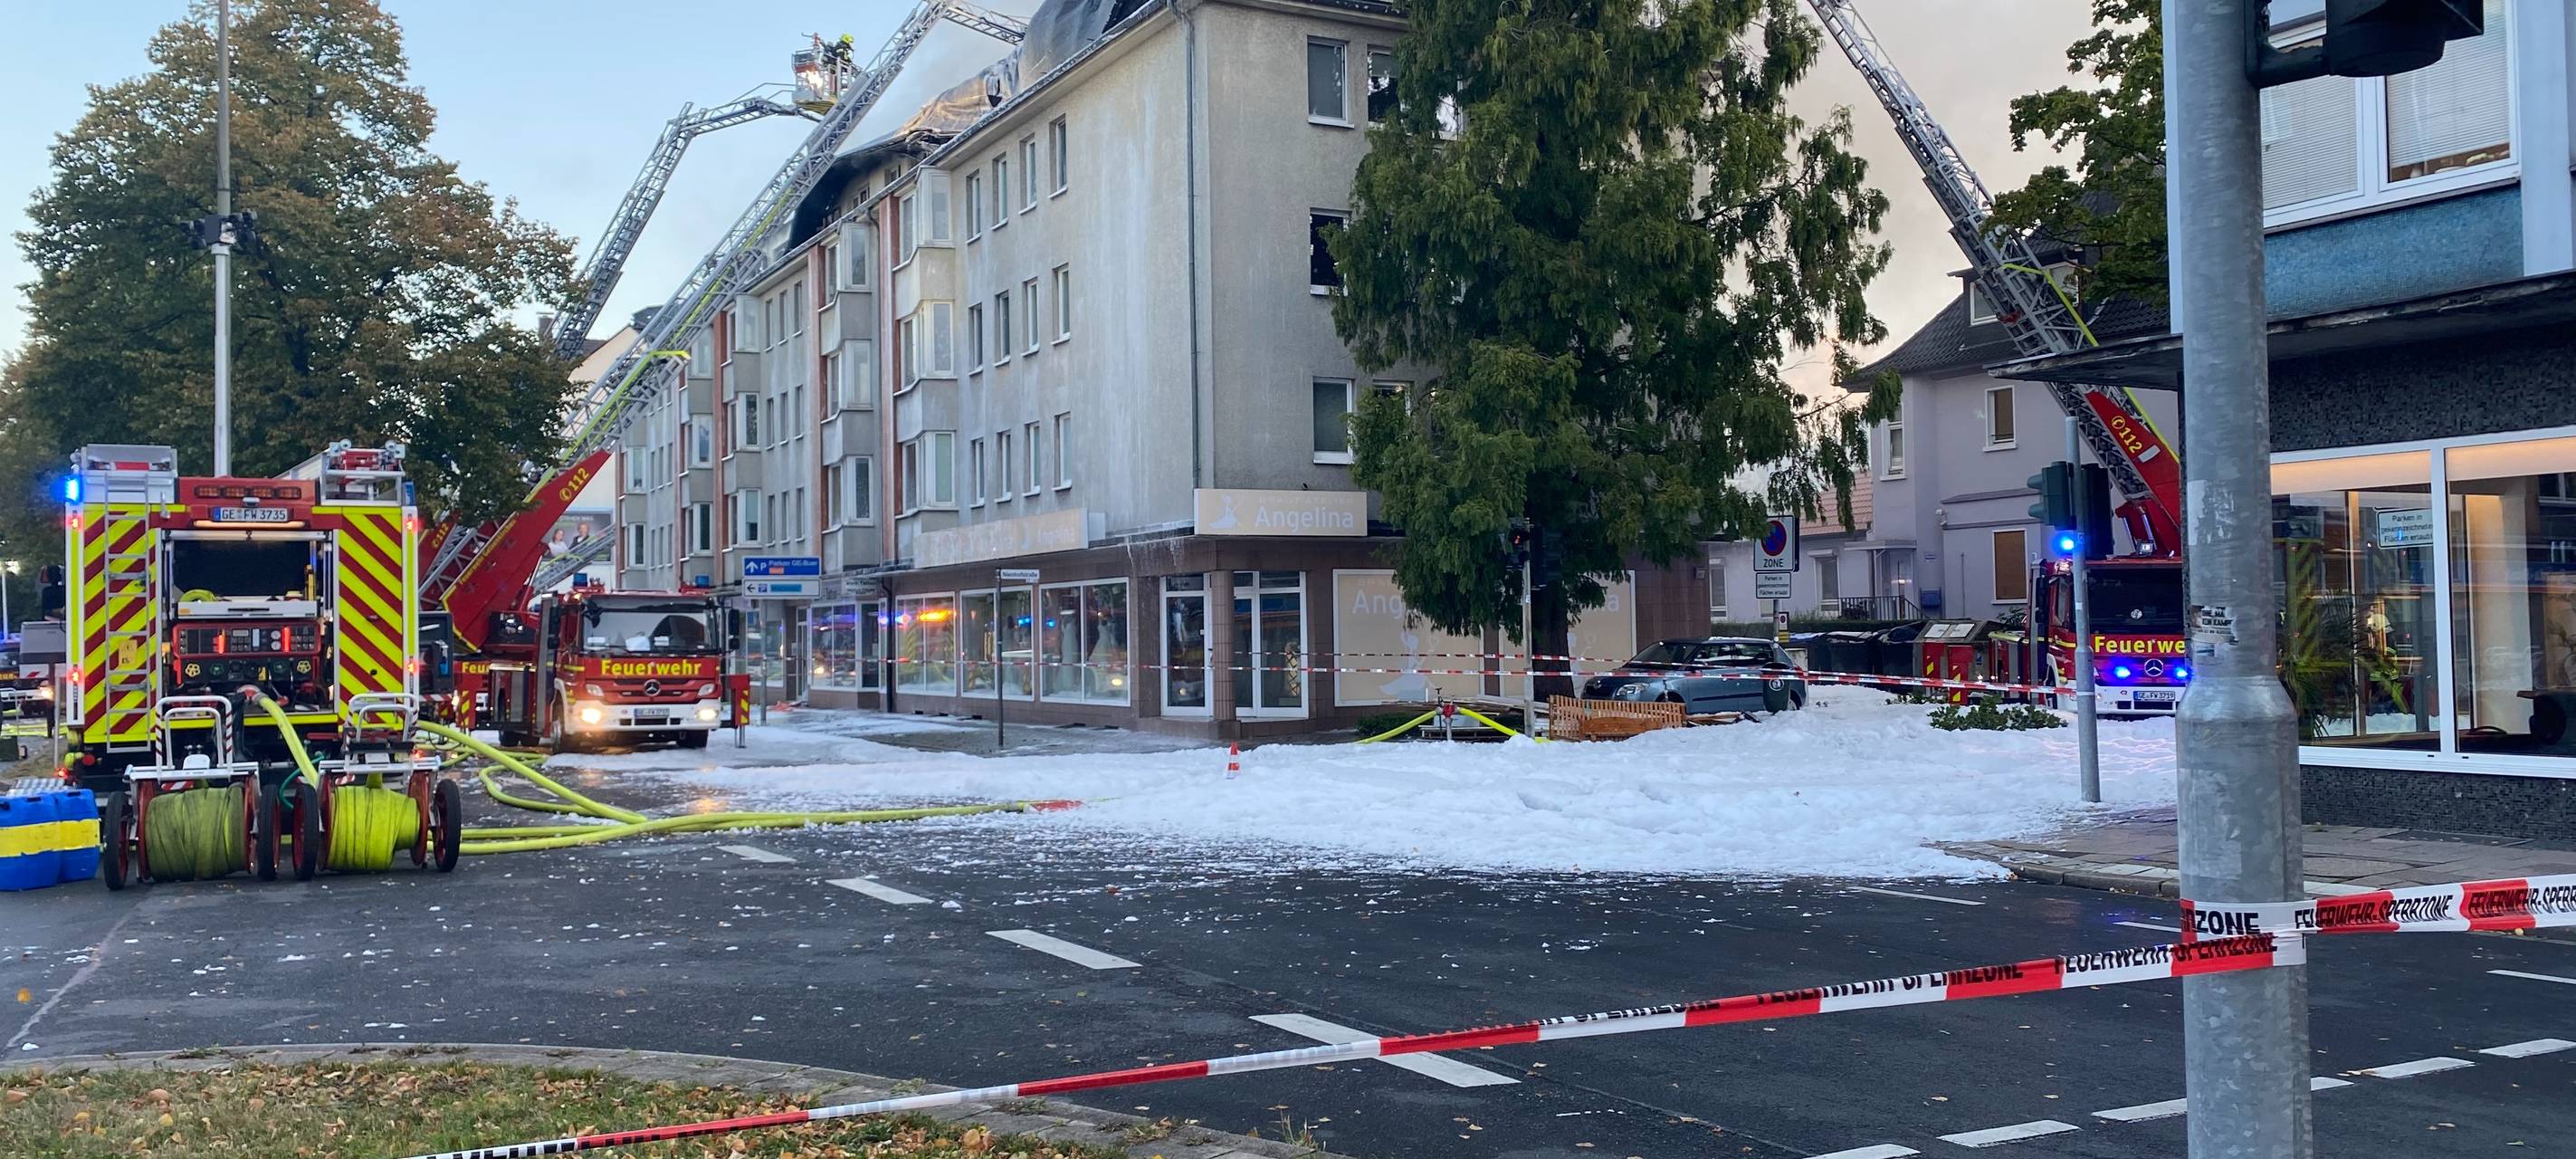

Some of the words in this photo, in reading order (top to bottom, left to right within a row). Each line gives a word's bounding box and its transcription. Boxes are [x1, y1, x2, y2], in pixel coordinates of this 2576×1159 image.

[2119, 427, 2142, 453] 112
[568, 467, 590, 491] 112
[260, 510, 286, 520] 3735
[1255, 506, 1354, 532] Angelina
[1763, 559, 1783, 567] ZONE
[601, 659, 701, 675] Feuerwehr
[2295, 894, 2455, 930] FEUERWEHR-SPERRZONE
